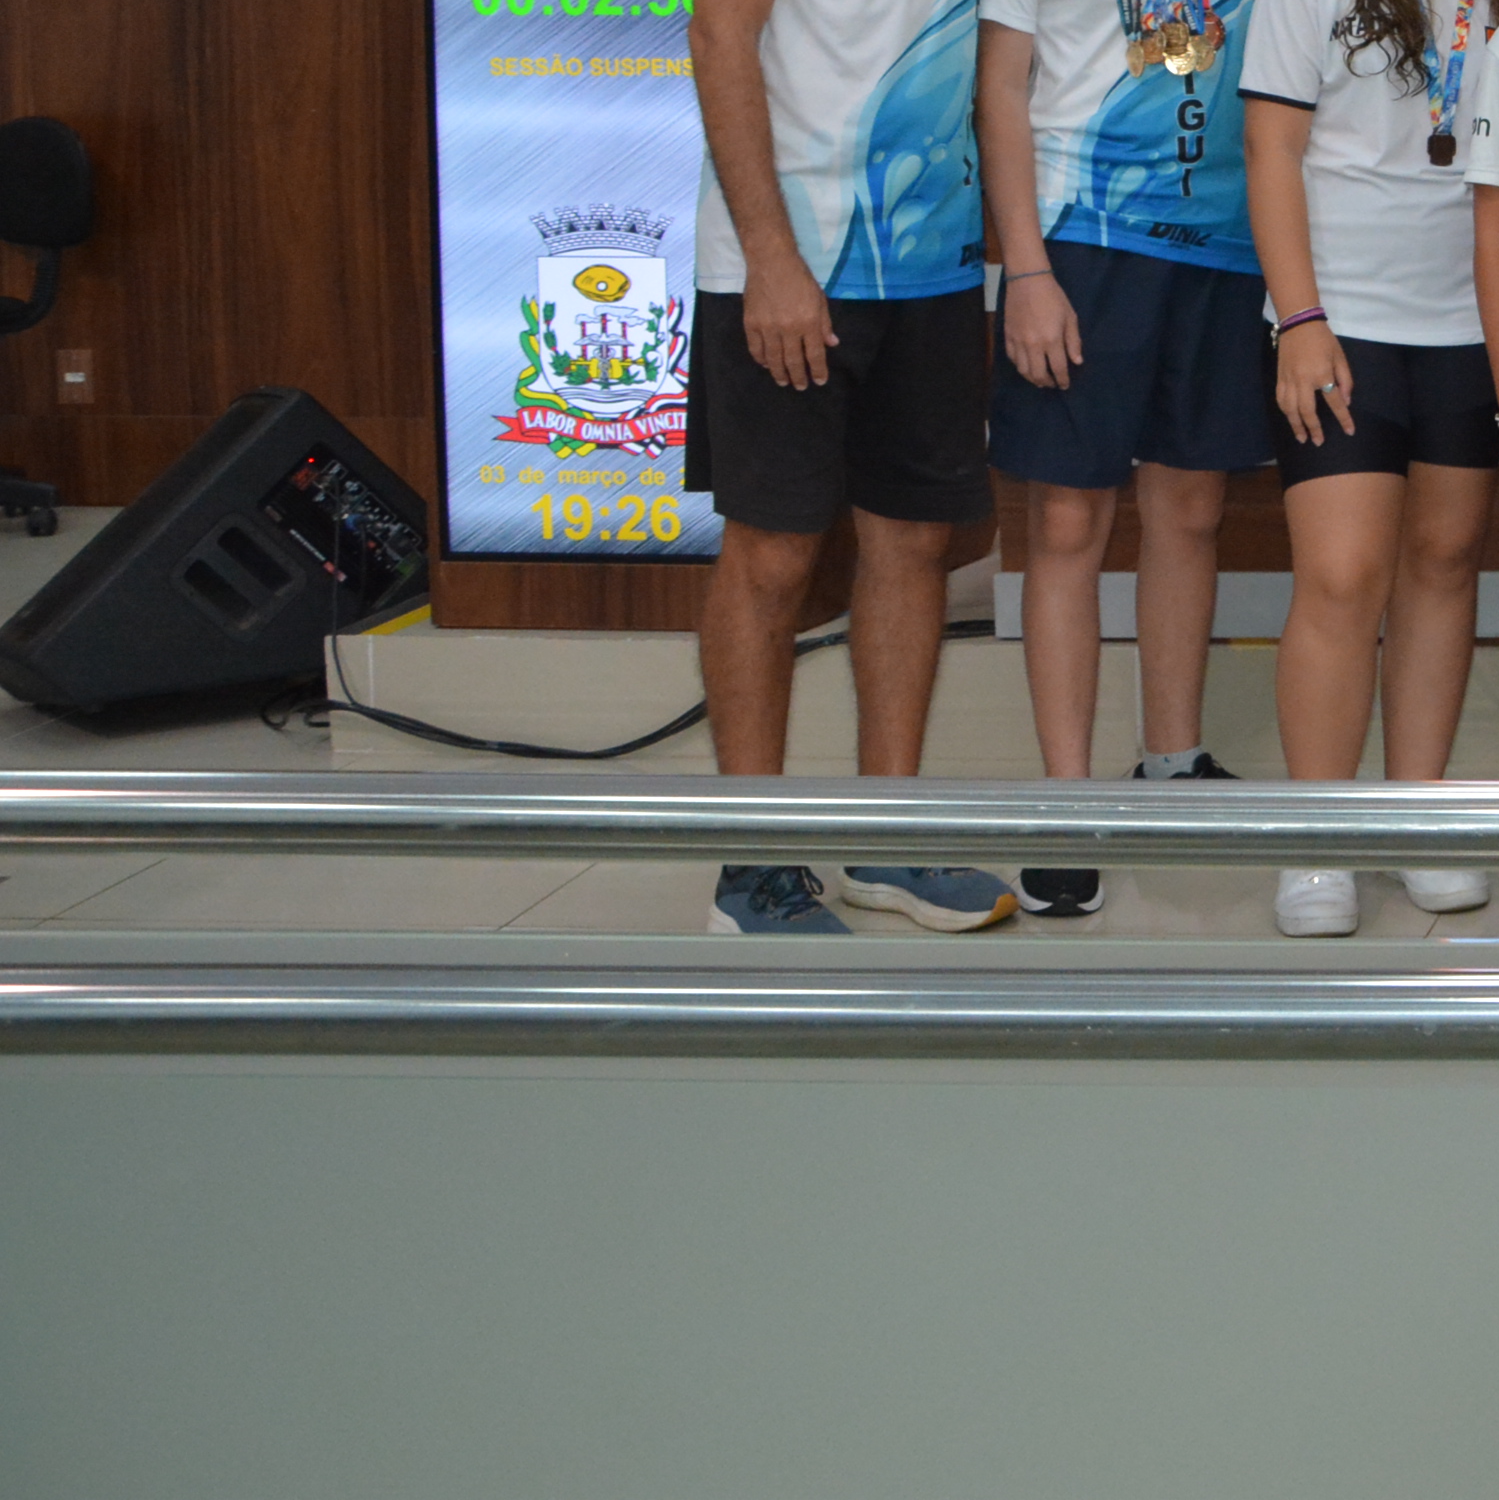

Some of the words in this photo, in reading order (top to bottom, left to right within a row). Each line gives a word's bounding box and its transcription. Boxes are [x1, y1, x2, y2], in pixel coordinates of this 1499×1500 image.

[489, 53, 584, 77] SESSÃO
[590, 57, 694, 77] SUSPENS
[1147, 222, 1212, 247] DINIZ
[523, 410, 577, 434] LABOR
[581, 421, 634, 441] OMNIA
[480, 465, 505, 483] 03
[519, 466, 545, 484] de
[558, 469, 626, 488] março
[640, 467, 666, 485] de
[530, 494, 682, 543] 19:26
